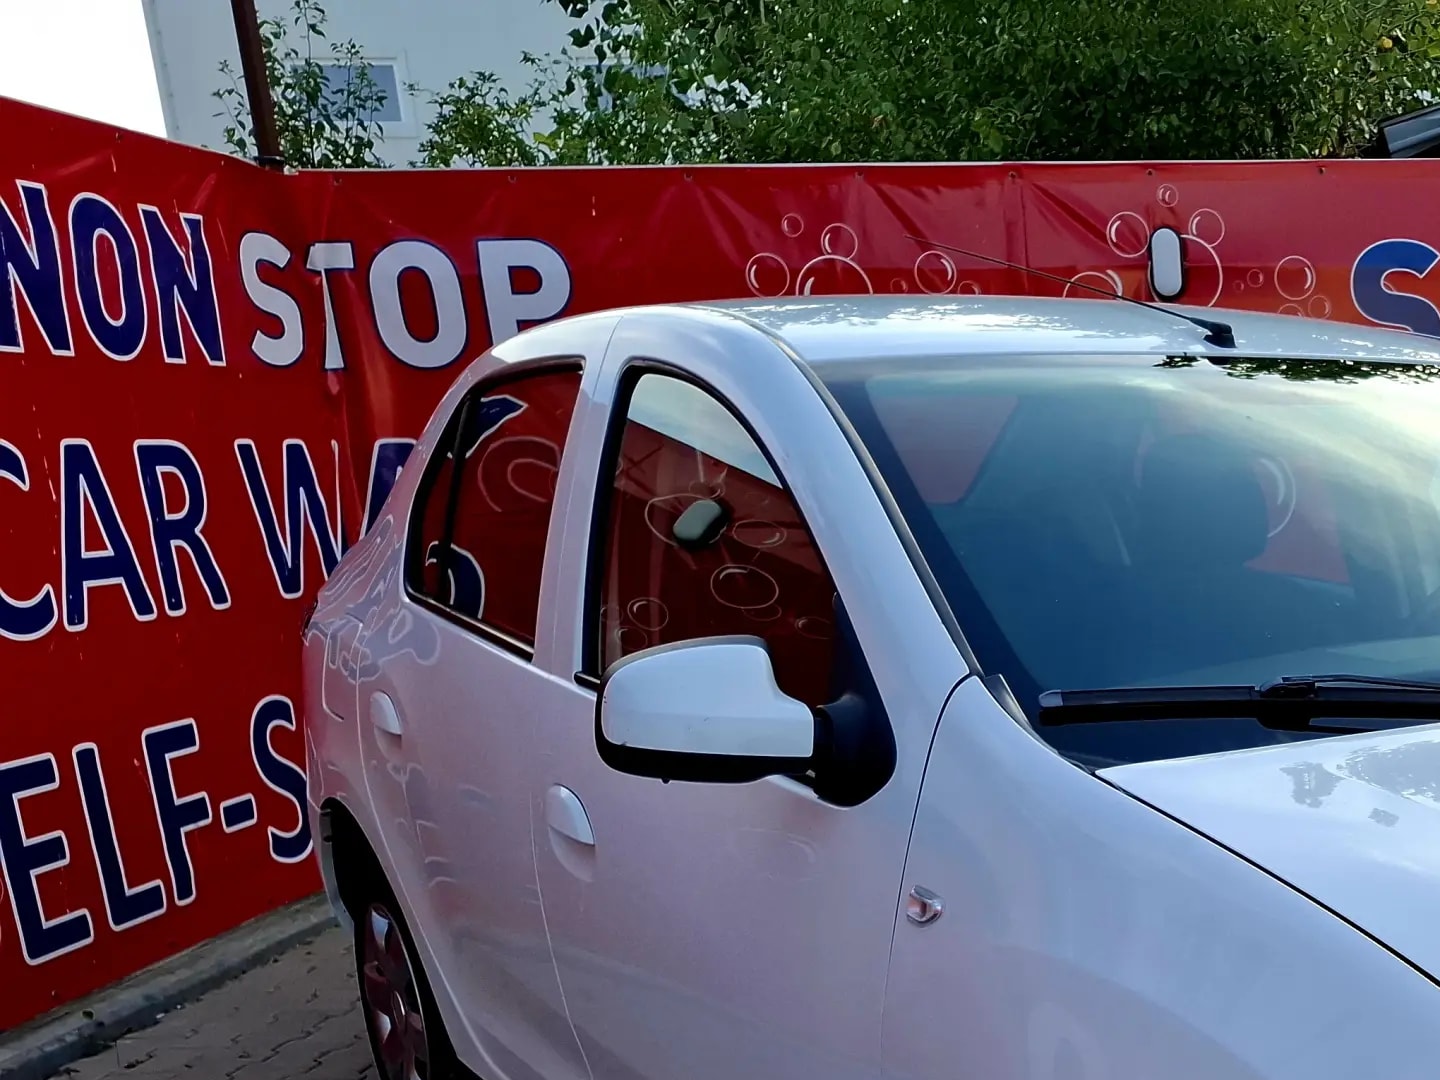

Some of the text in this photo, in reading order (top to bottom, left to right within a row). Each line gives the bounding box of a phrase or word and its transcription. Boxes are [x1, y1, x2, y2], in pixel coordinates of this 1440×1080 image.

[0, 179, 573, 371] NON STOP
[0, 438, 231, 641] CAR
